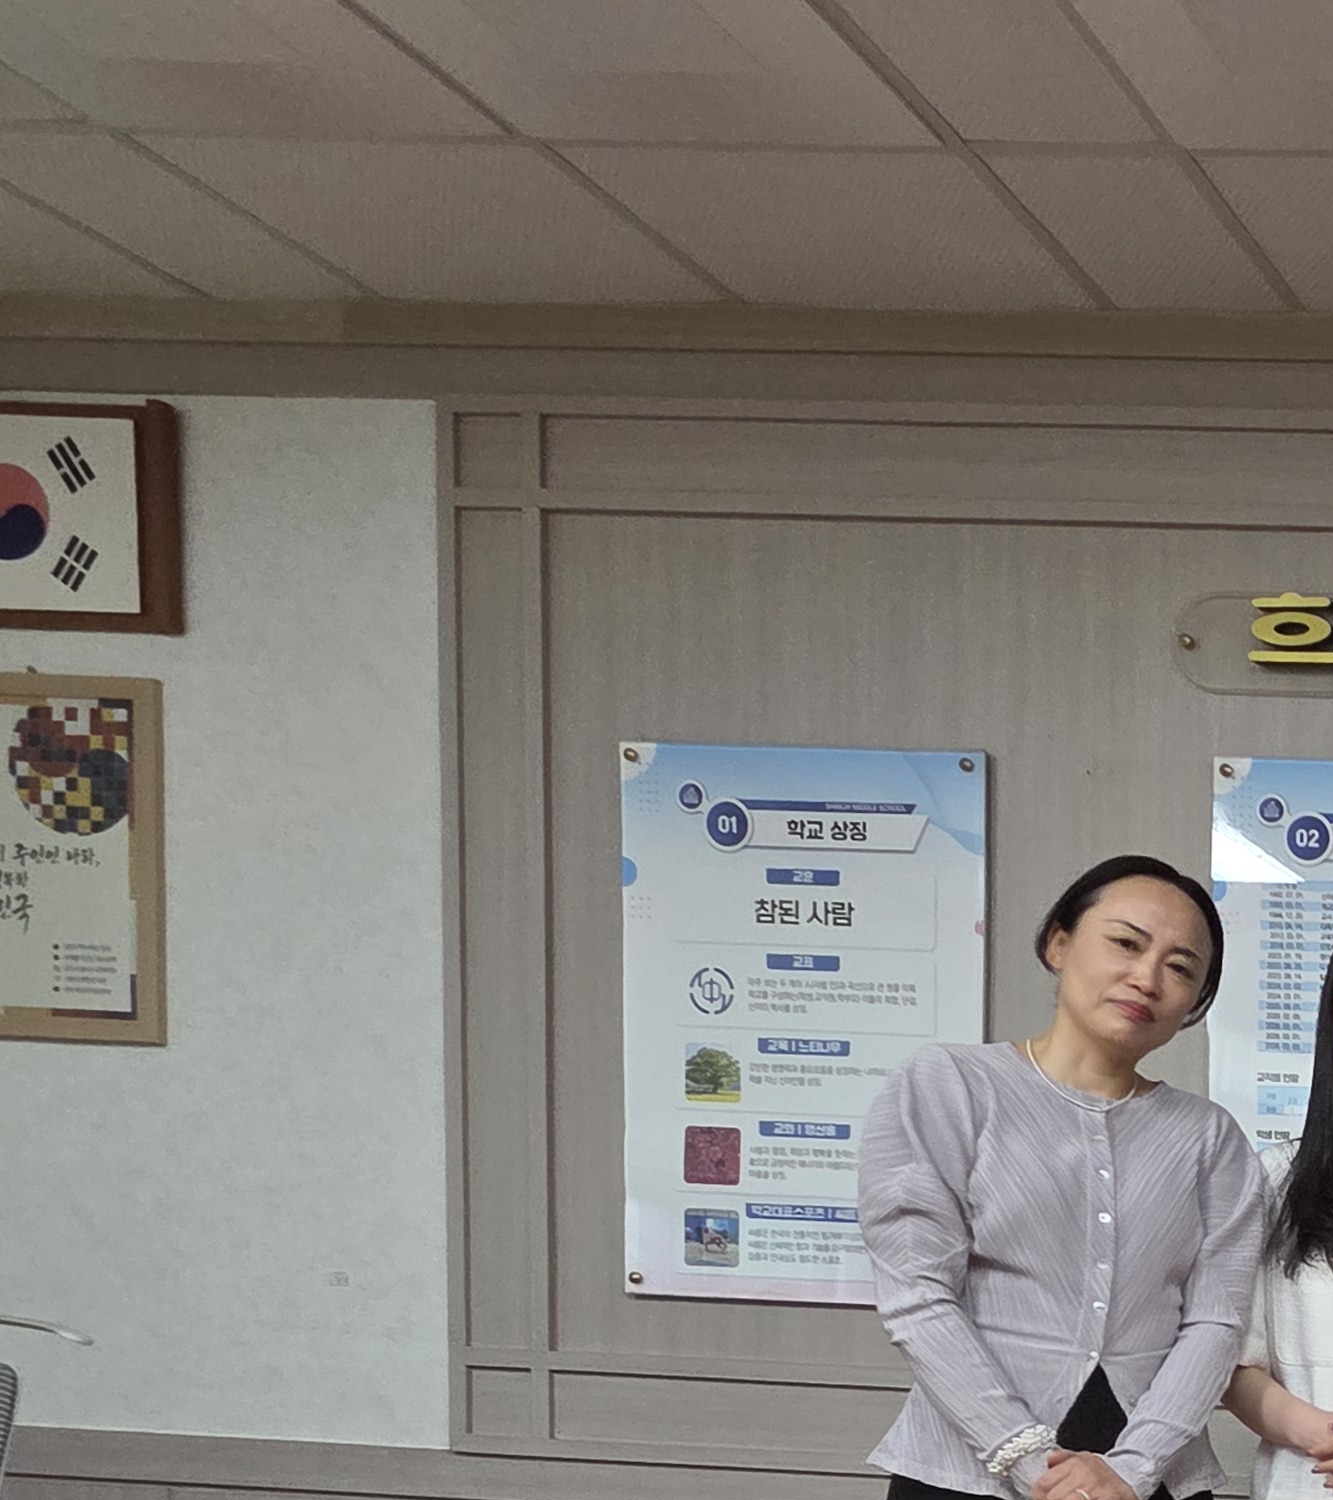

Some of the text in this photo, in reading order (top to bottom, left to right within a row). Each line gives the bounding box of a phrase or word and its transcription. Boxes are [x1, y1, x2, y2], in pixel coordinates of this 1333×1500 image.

[717, 815, 738, 834] 01
[786, 819, 868, 841] 학교 상징
[1295, 829, 1320, 848] 02
[754, 898, 855, 927] 참된 사람
[799, 1040, 841, 1053] 느티나무
